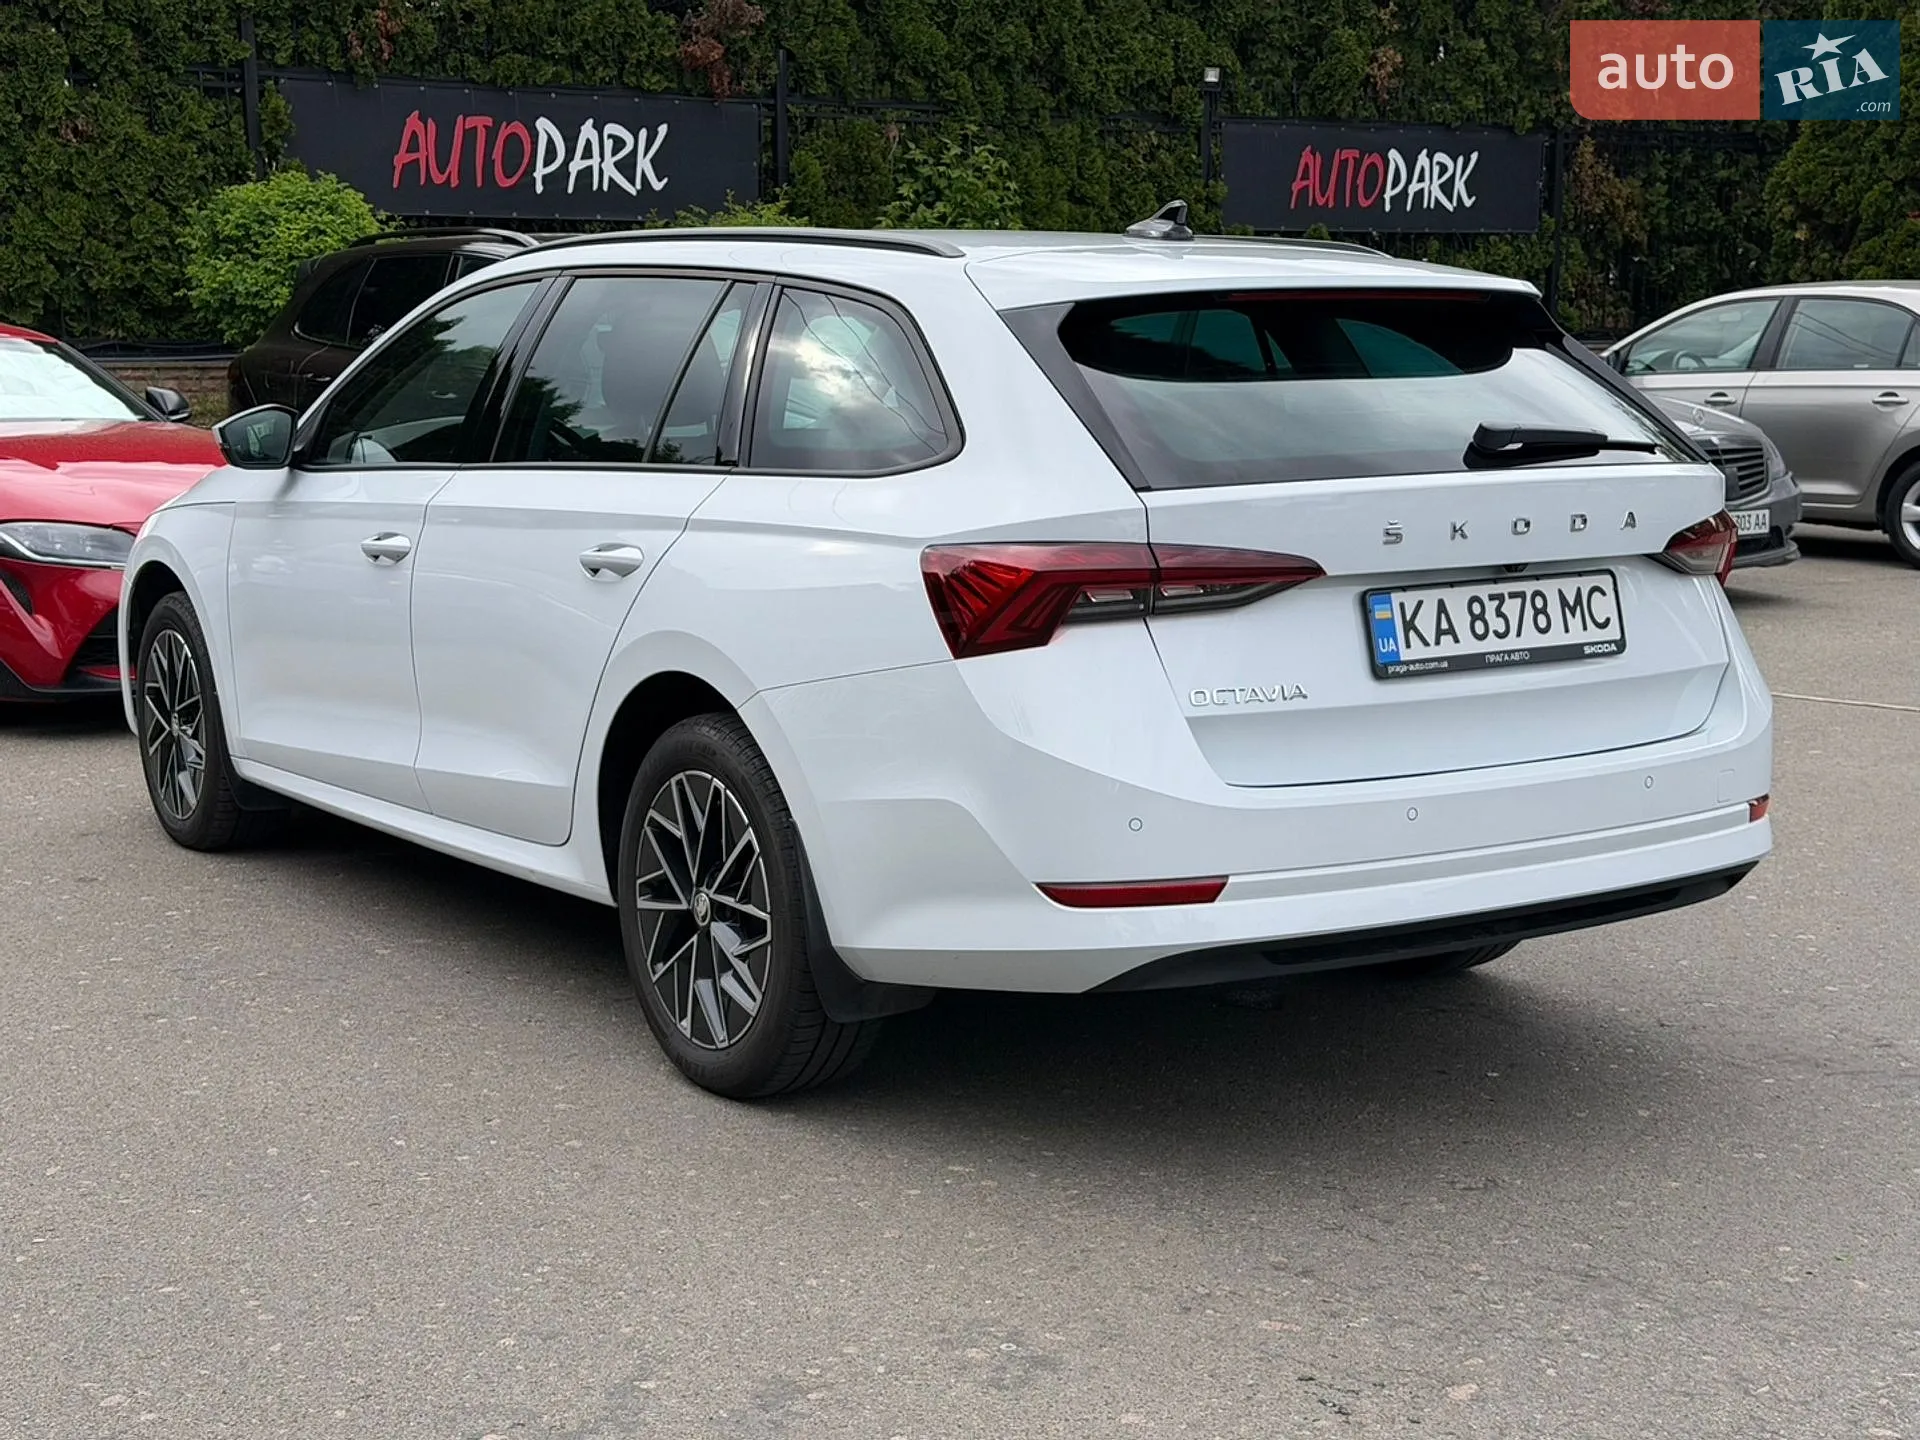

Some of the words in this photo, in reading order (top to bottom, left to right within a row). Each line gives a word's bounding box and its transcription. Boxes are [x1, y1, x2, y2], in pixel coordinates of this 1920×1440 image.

[393, 110, 669, 196] AUTOPARK
[1290, 145, 1479, 212] AUTOPARK
[1382, 510, 1638, 546] ŠKODA
[1753, 514, 1767, 530] AA
[1399, 598, 1461, 649] KA
[1467, 589, 1552, 641] 8378
[1557, 585, 1612, 634] MC
[1378, 637, 1398, 653] UA
[1583, 643, 1618, 654] SKODA
[1387, 660, 1449, 674] praga-auto.com.ua
[1189, 683, 1308, 707] OCTAVIA
